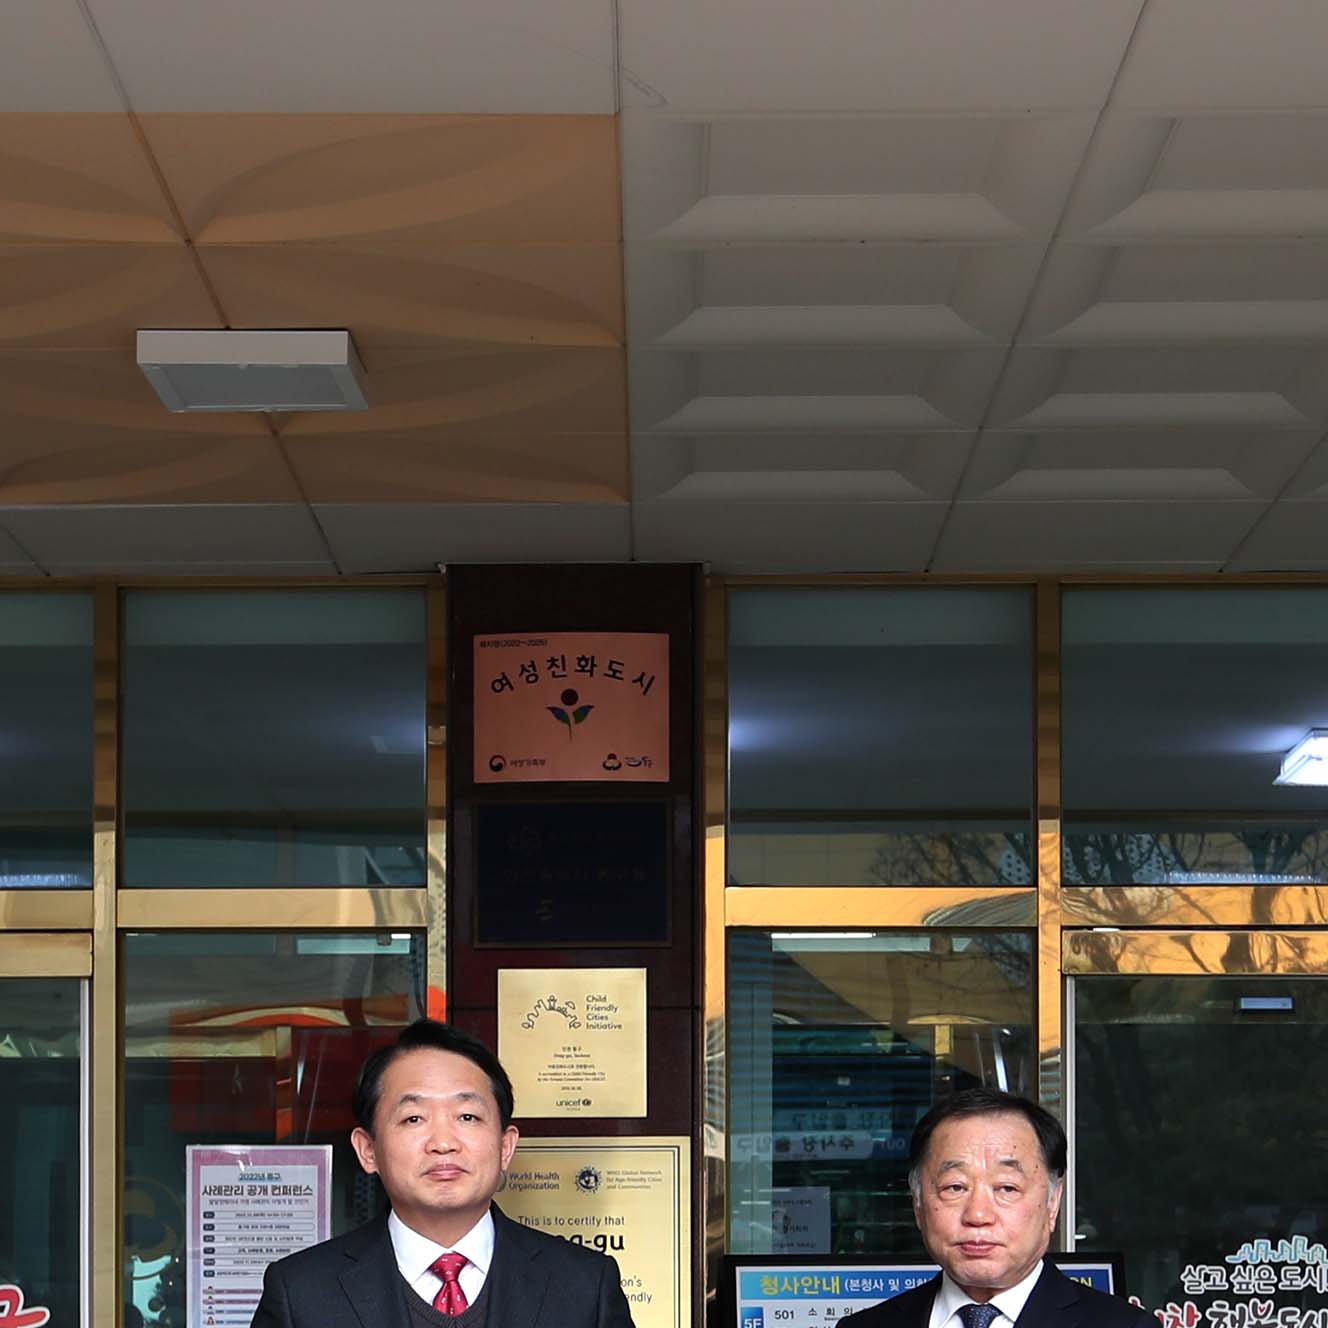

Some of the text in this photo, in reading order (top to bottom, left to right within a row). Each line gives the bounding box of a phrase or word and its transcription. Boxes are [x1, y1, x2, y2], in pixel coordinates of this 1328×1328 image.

[491, 655, 655, 695] 여성친화도시
[586, 1005, 618, 1013] Friendly
[509, 1172, 559, 1181] World Health
[202, 1185, 312, 1195] 사례관리 공개 컨퍼런스
[509, 1182, 559, 1191] Organization
[518, 1215, 624, 1227] This is to certify that
[1180, 1264, 1229, 1294] 살고
[1232, 1264, 1277, 1294] 싶은
[760, 1277, 840, 1295] 청사안내
[889, 1279, 899, 1291] 및
[774, 1311, 794, 1319] 501
